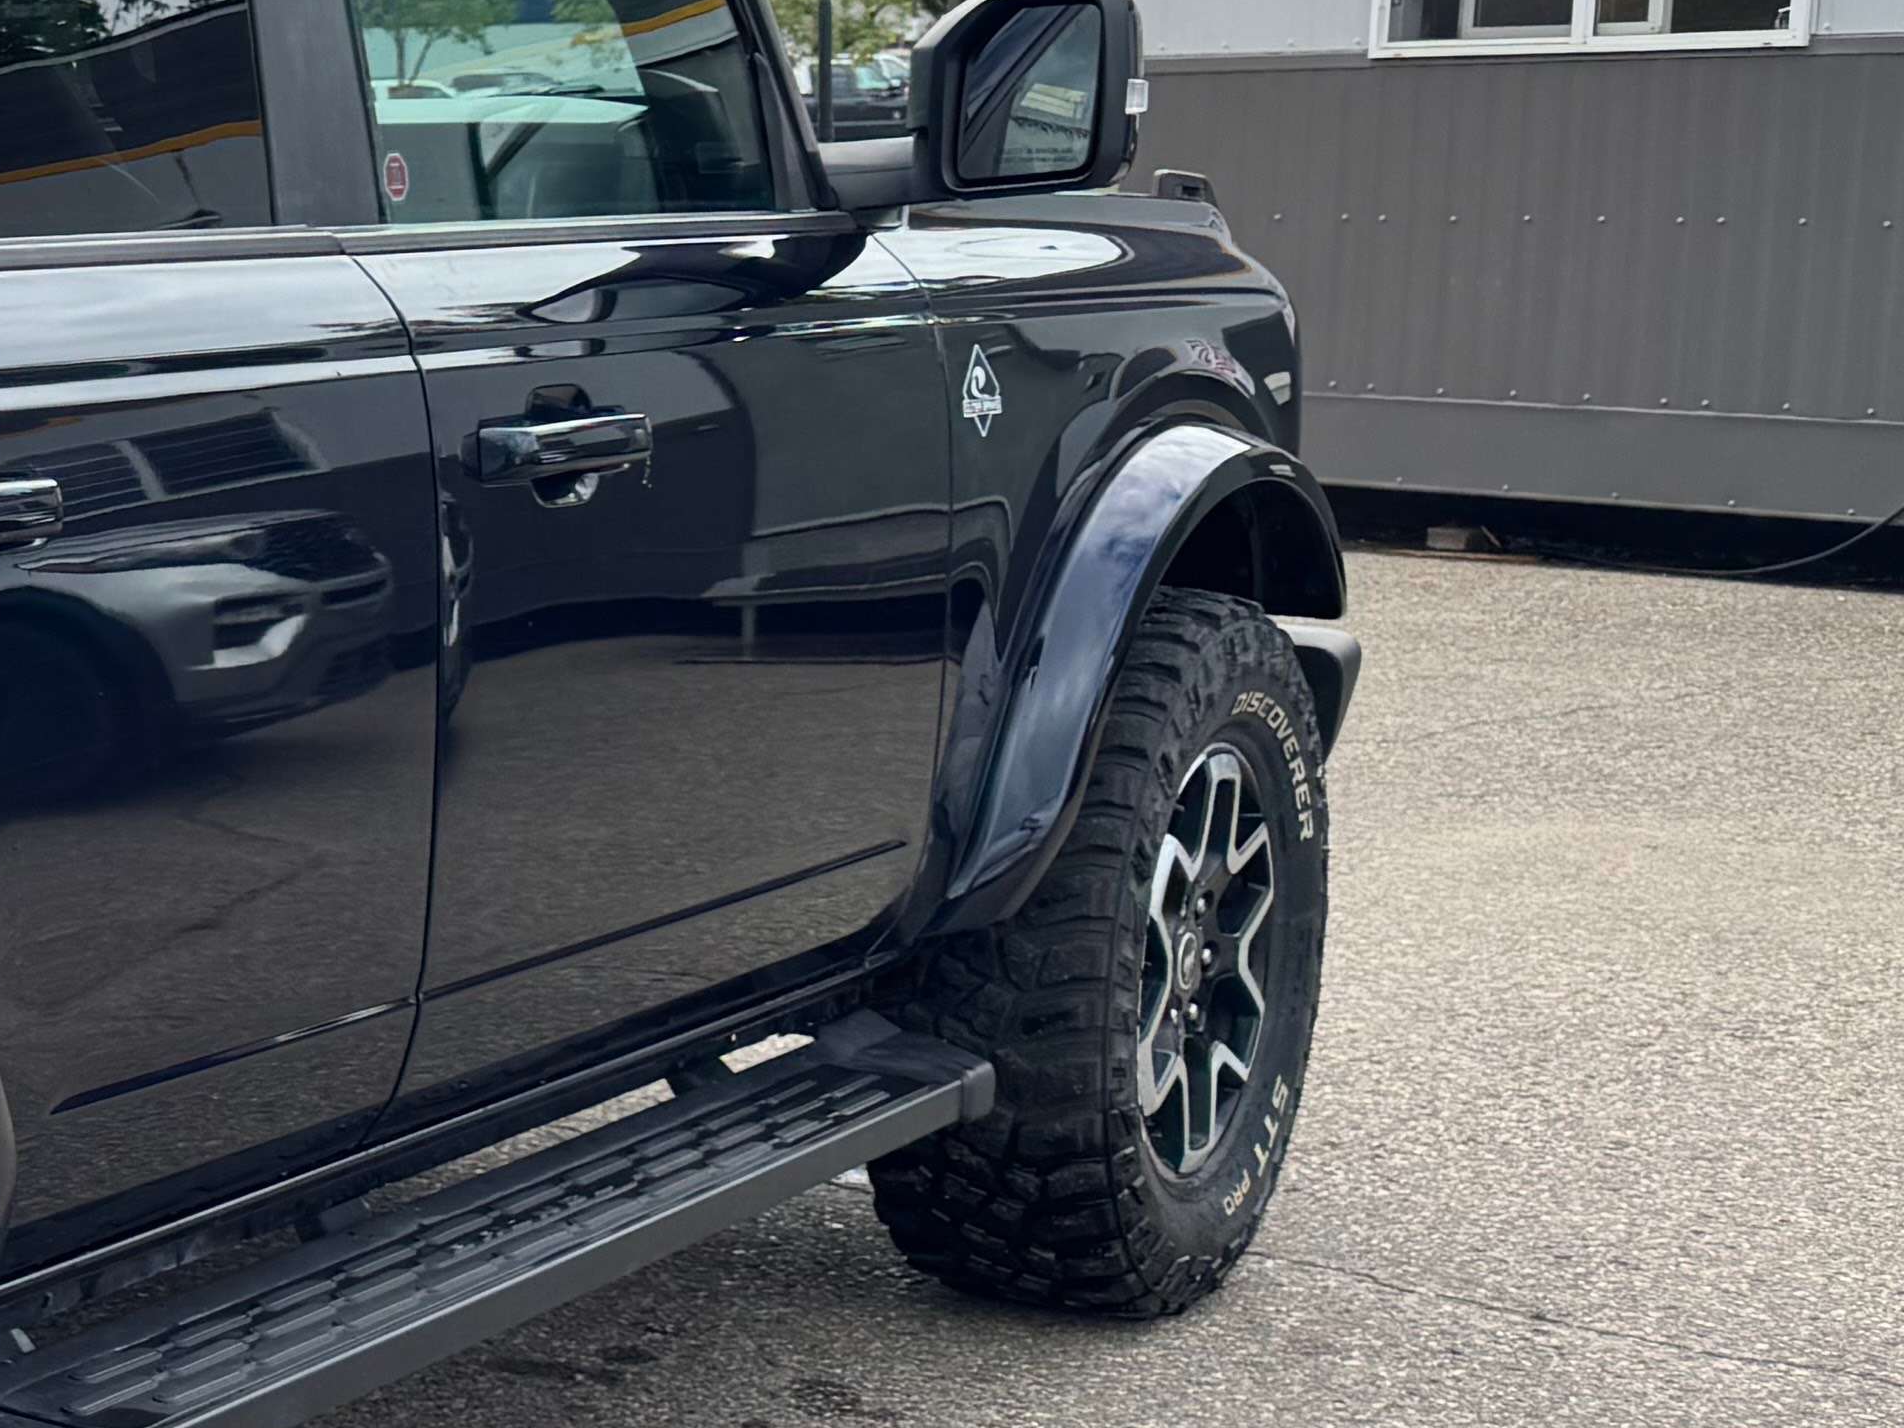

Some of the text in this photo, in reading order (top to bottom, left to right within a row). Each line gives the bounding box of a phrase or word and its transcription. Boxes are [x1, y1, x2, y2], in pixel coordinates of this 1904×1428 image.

[1231, 690, 1314, 842] DISCOVERER
[1223, 1073, 1288, 1216] STT PRO
